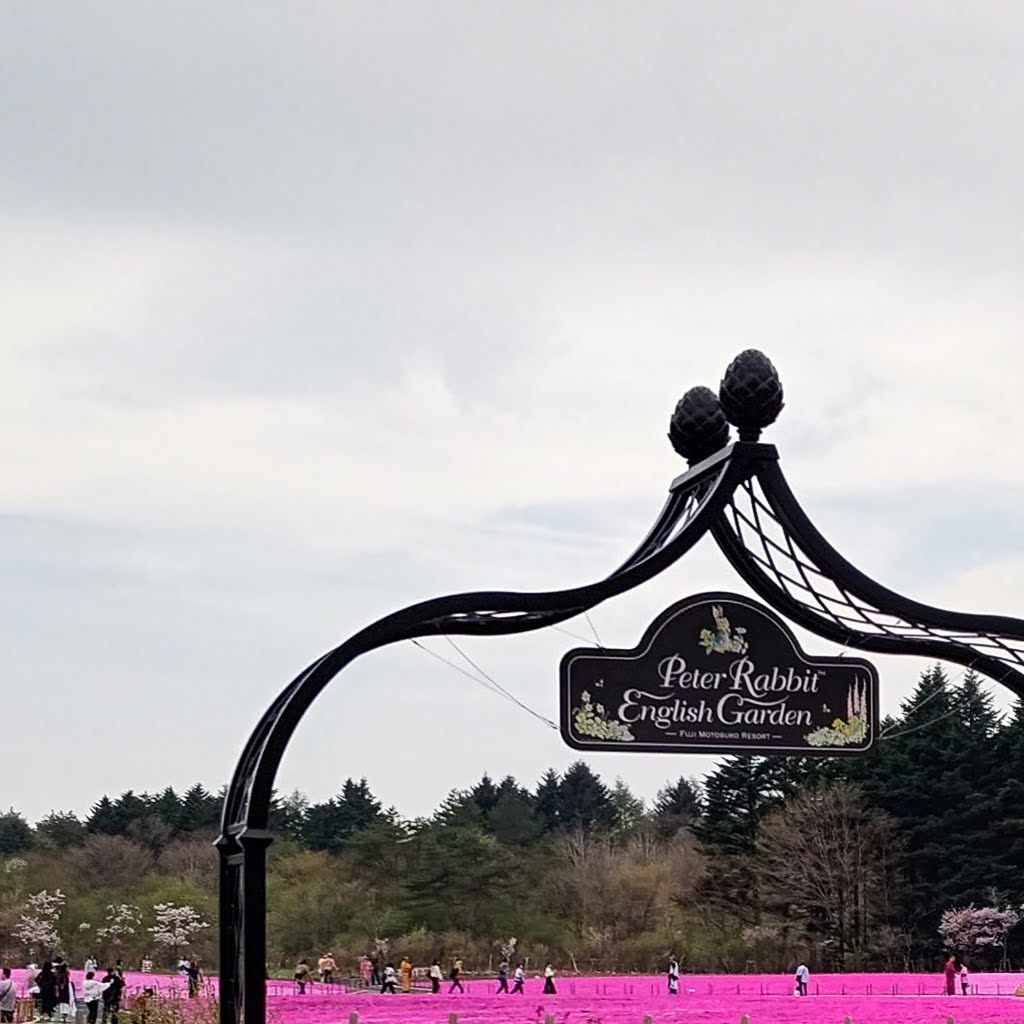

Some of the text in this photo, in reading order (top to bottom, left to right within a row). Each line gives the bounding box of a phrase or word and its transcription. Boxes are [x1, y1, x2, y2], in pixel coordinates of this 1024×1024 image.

[658, 654, 727, 690] Peter
[618, 689, 813, 729] English Garden
[741, 732, 771, 740] RESORT
